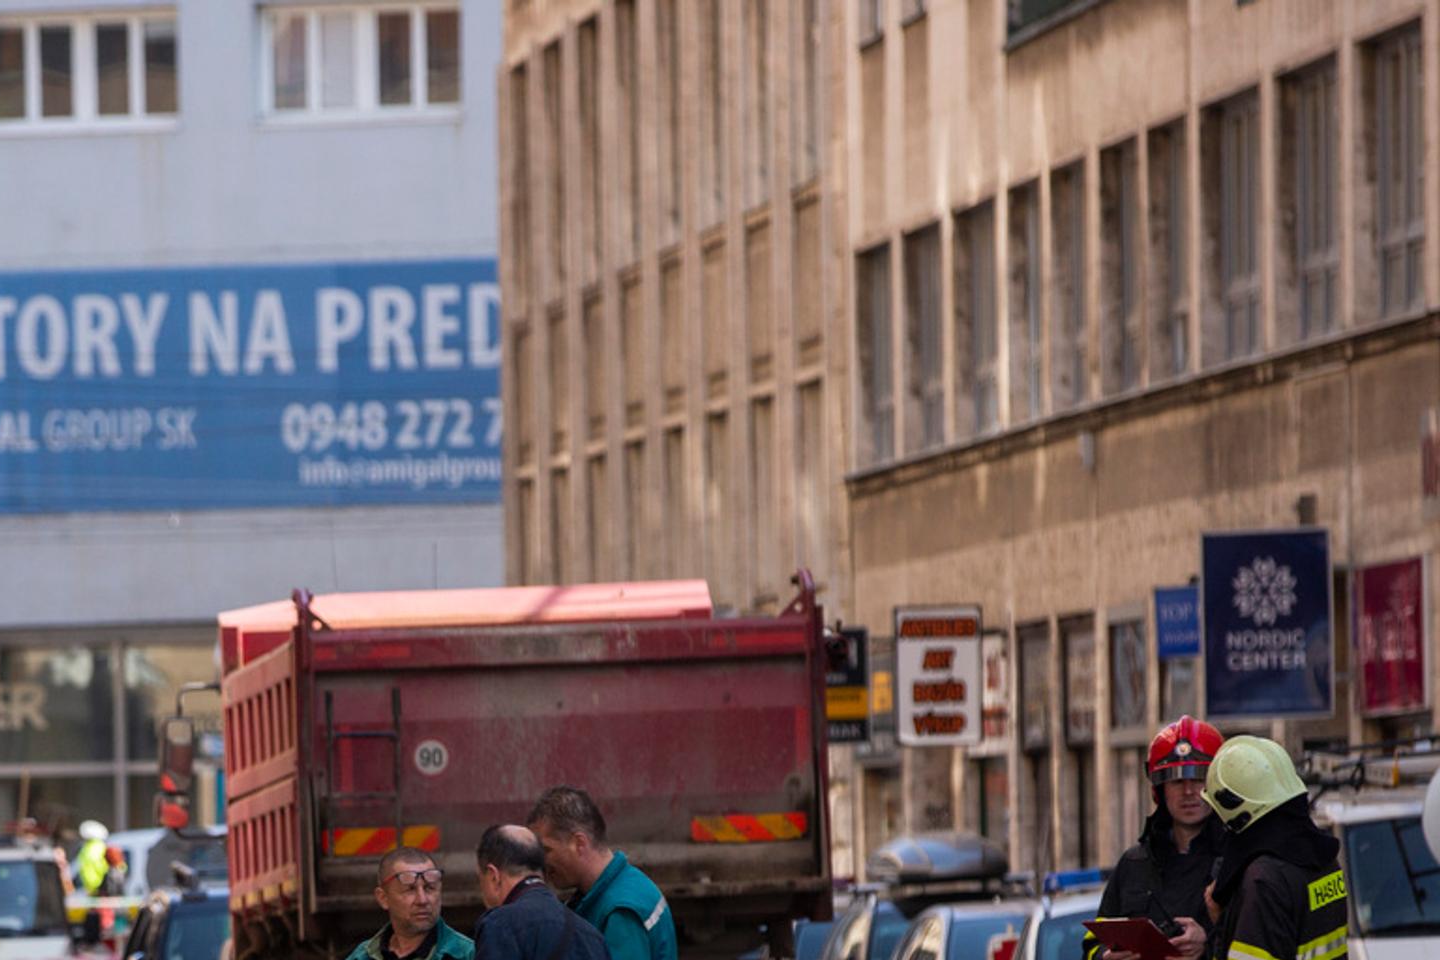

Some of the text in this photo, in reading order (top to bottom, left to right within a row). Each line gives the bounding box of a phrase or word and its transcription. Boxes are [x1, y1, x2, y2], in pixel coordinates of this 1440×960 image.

[188, 289, 295, 377] NA
[316, 282, 500, 372] PRED
[42, 408, 151, 453] GROUP
[157, 406, 198, 450] SK
[281, 400, 389, 453] 0948
[395, 398, 474, 449] 272
[1225, 629, 1307, 651] NORDIC
[1226, 651, 1307, 671] CENTER
[419, 747, 443, 768] 90
